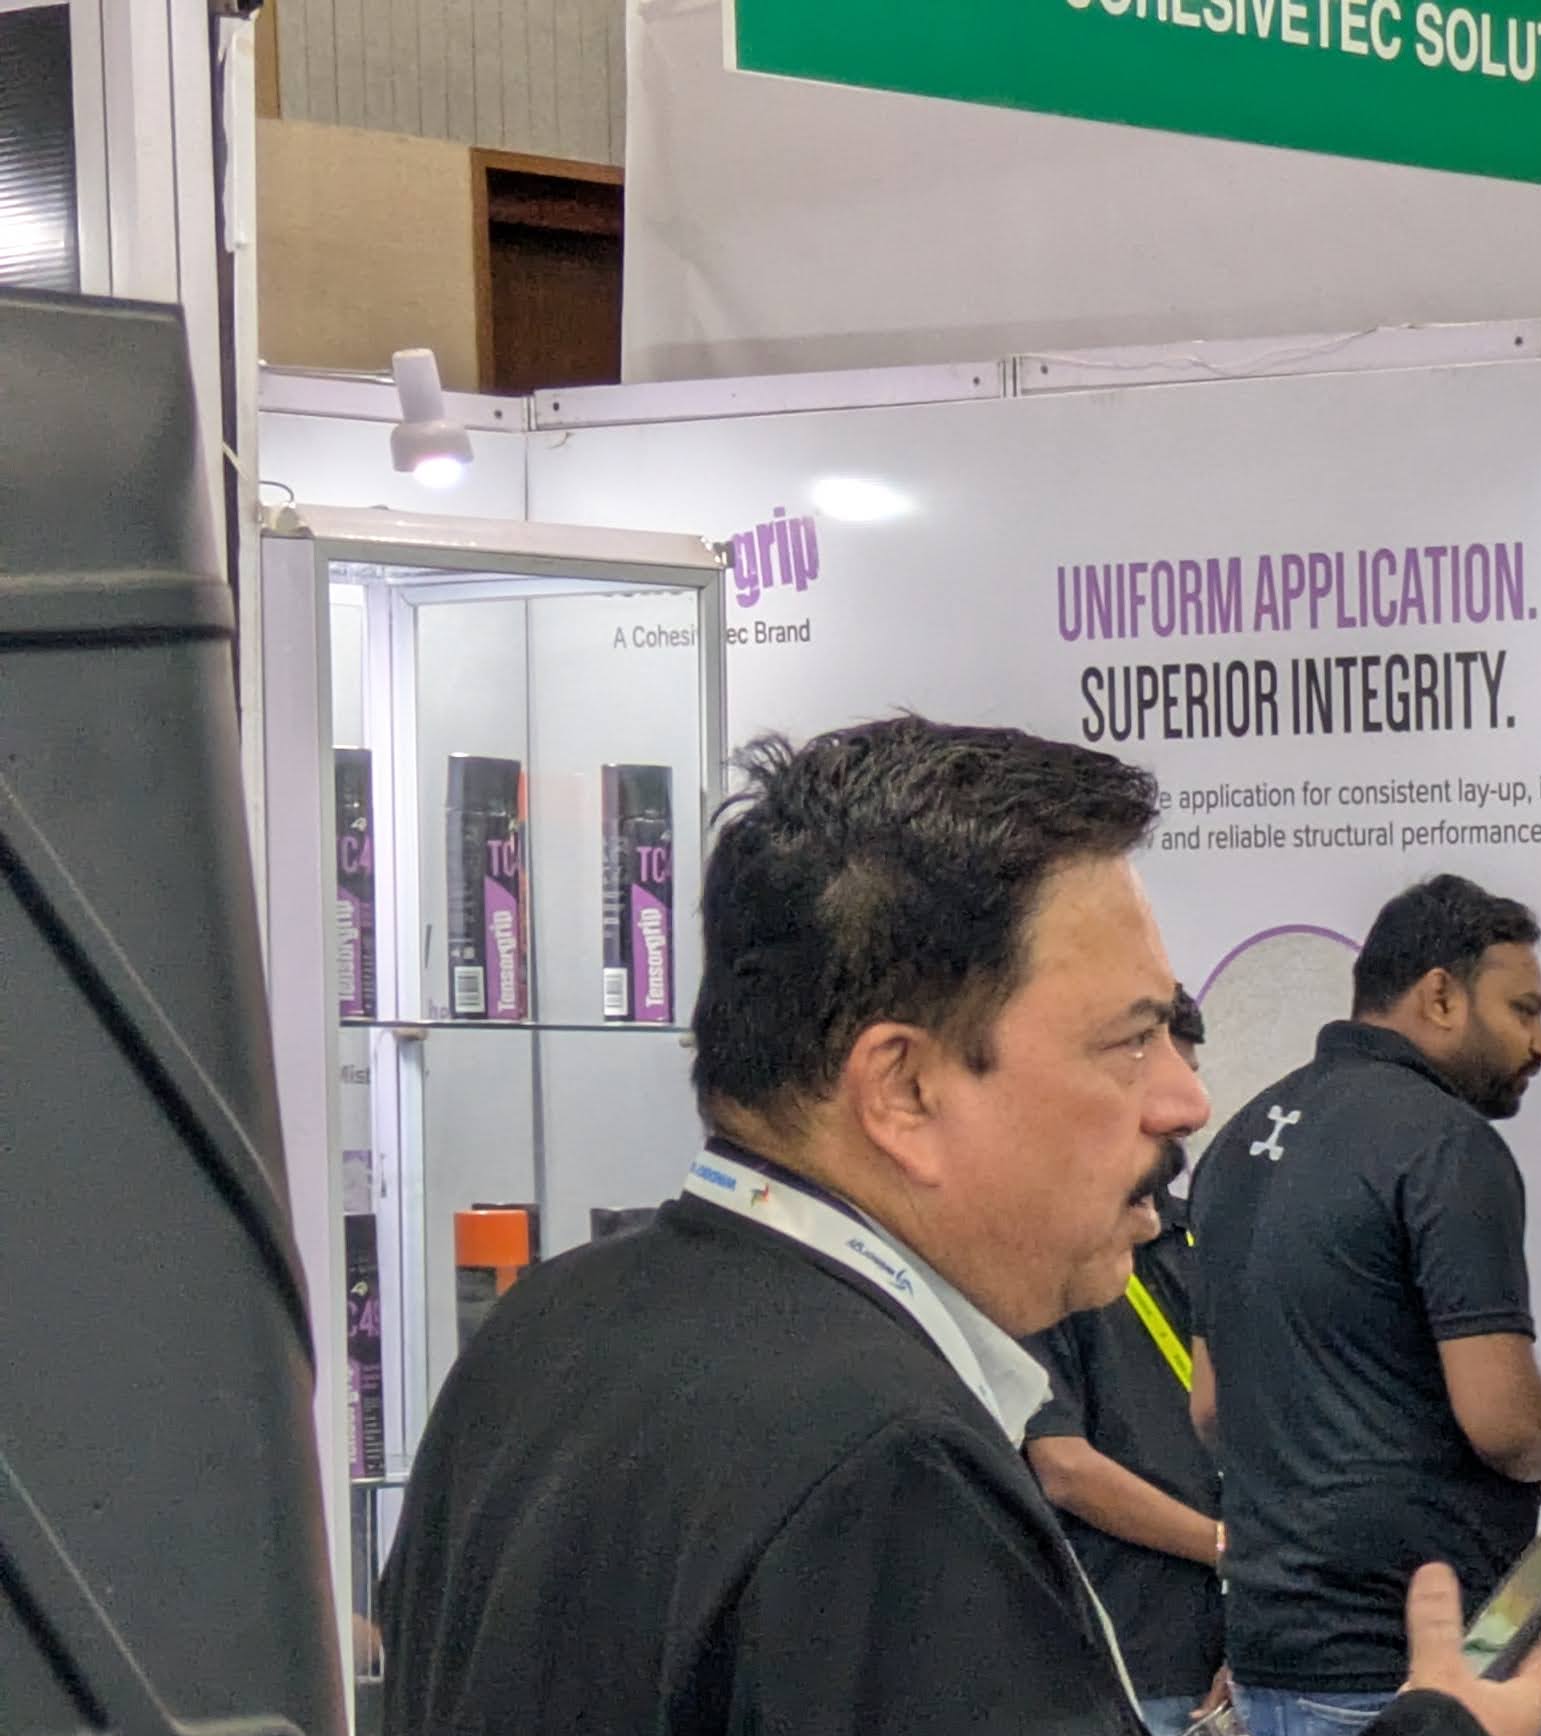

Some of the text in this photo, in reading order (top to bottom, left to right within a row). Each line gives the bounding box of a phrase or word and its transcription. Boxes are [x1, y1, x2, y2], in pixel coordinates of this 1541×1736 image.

[1064, 0, 1402, 59] SIVETEC
[732, 507, 819, 608] grip
[1057, 540, 1537, 642] UNIFORM APPLICATION.
[614, 627, 626, 648] A
[755, 618, 810, 644] Brand
[1082, 650, 1515, 743] SUPERIOR INTEGRITY.
[1179, 780, 1296, 815] application
[1302, 780, 1333, 806] for
[1339, 777, 1452, 806] consistent
[1459, 776, 1532, 809] lay-up,
[1162, 823, 1200, 850] and
[1208, 822, 1285, 849] reliable
[1293, 820, 1393, 848] structural
